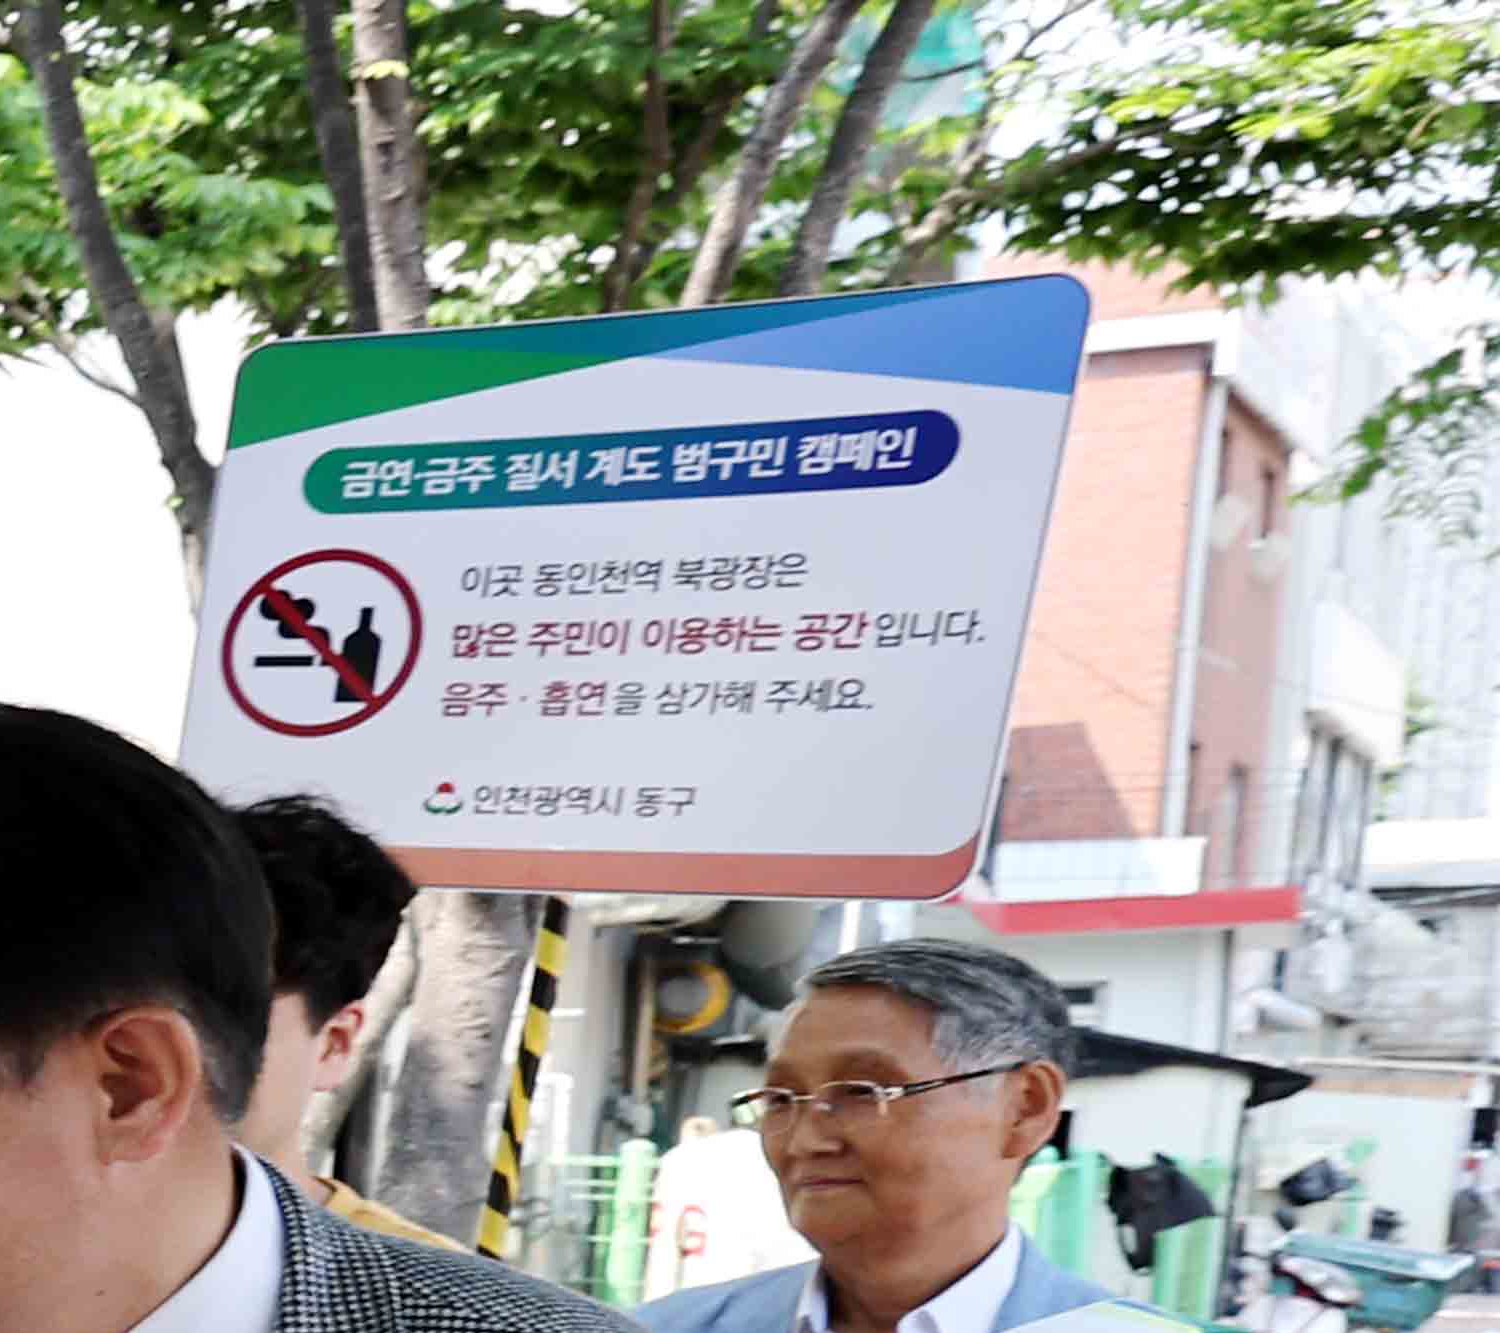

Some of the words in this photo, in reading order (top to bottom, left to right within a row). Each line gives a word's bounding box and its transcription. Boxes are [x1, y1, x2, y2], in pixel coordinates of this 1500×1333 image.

[340, 452, 494, 501] 금연·금주
[504, 449, 577, 491] 질서
[587, 443, 659, 487] 계도
[671, 436, 786, 482] 범구민
[796, 426, 912, 475] 캠페인
[461, 562, 521, 597] 이곳
[532, 557, 663, 596] 동인천역
[672, 552, 807, 592] 북광장은
[453, 621, 517, 658] 많은
[527, 617, 628, 656] 주민이
[641, 617, 779, 654] 이용하는
[442, 681, 504, 716] 음주
[655, 680, 755, 715] 삼가해
[766, 677, 871, 714] 주세요.
[472, 784, 621, 817] 인천광역시
[633, 784, 695, 817] 동구
